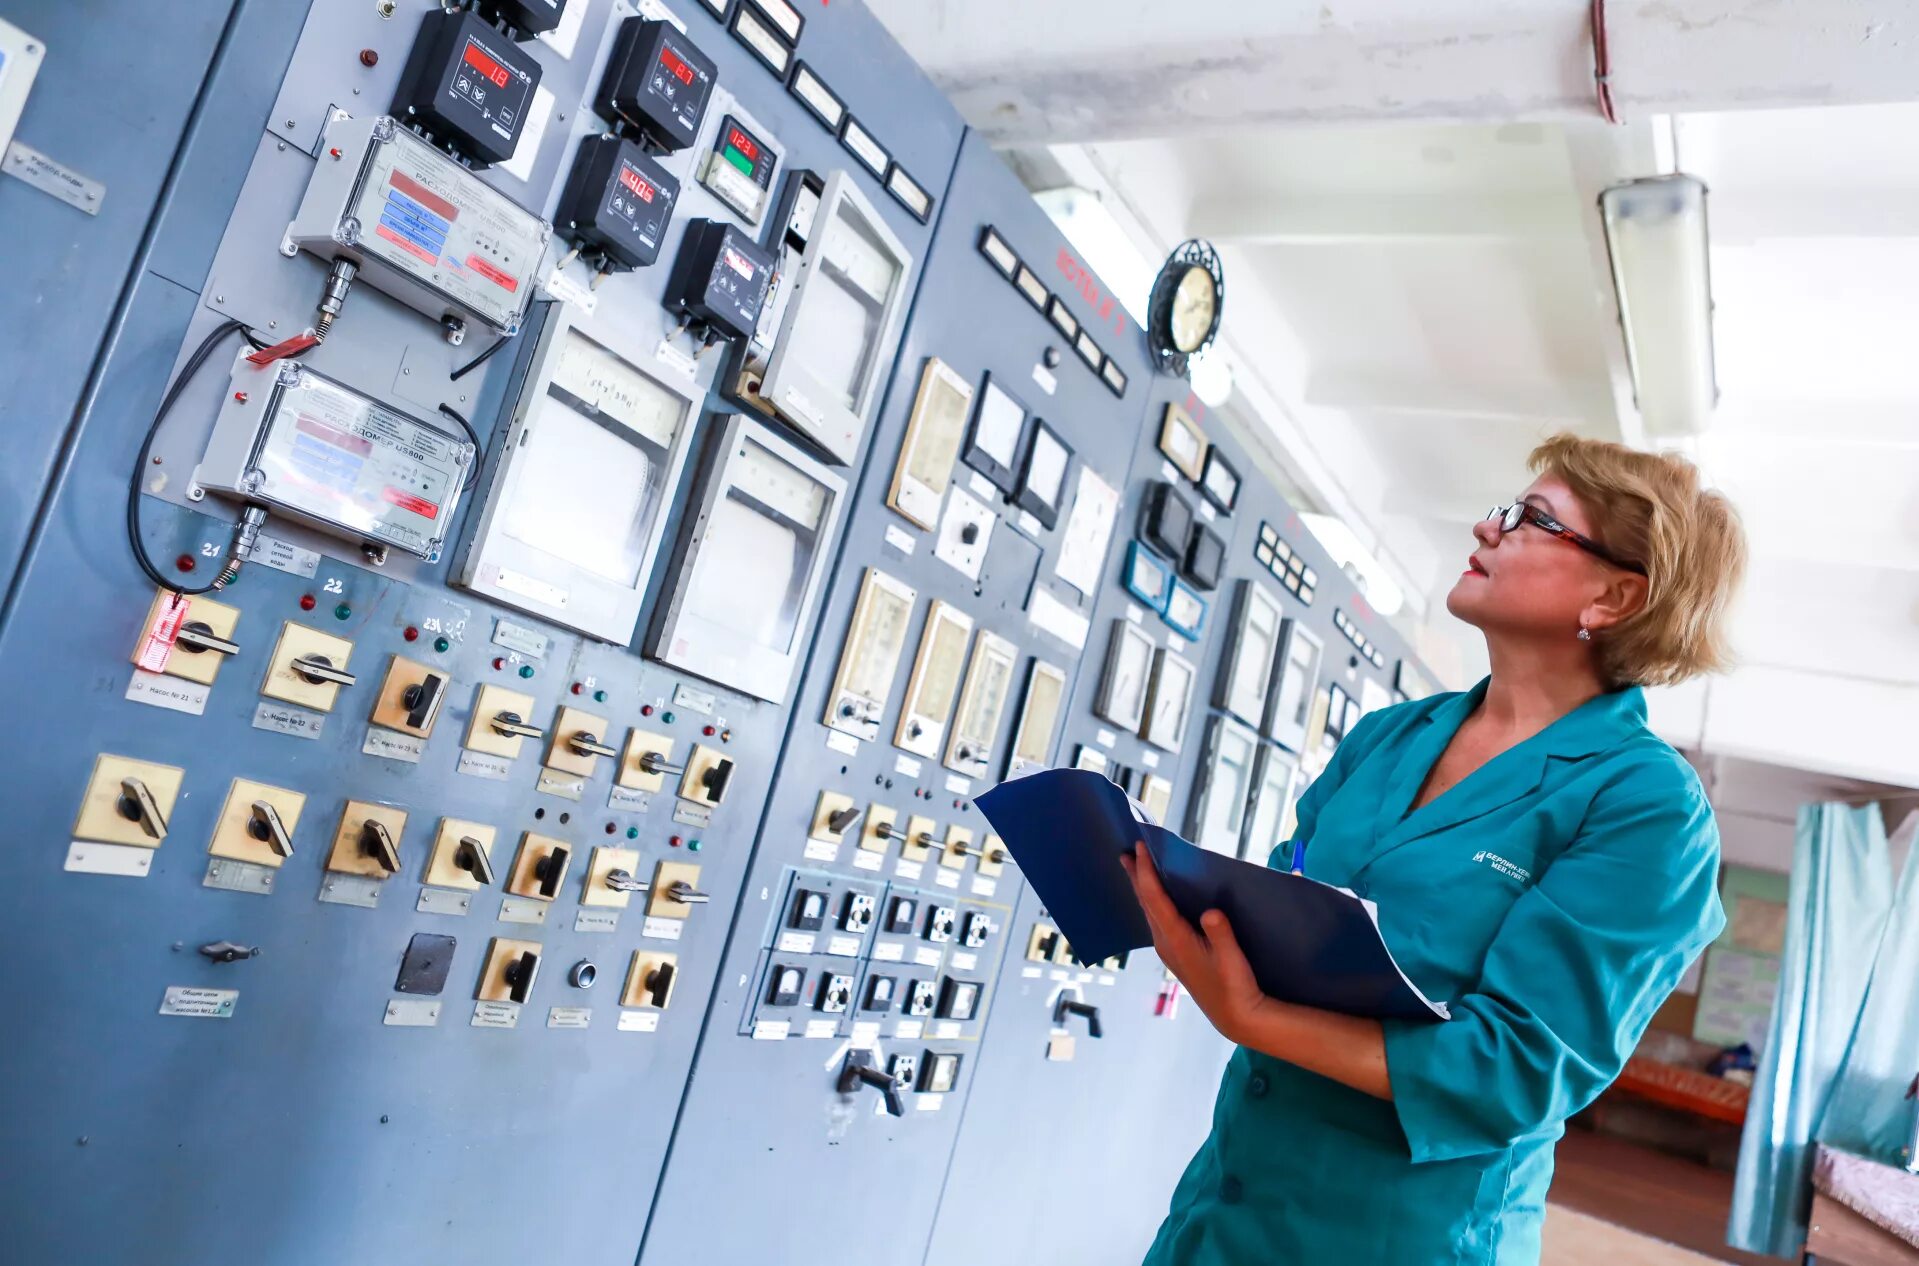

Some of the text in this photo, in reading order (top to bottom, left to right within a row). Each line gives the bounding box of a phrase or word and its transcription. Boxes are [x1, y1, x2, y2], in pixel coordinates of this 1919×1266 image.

[395, 444, 424, 461] US800
[273, 541, 294, 553] Расход
[271, 550, 293, 560] сетевой
[270, 558, 286, 567] воды
[323, 577, 343, 595] 22
[149, 686, 170, 698] Насос
